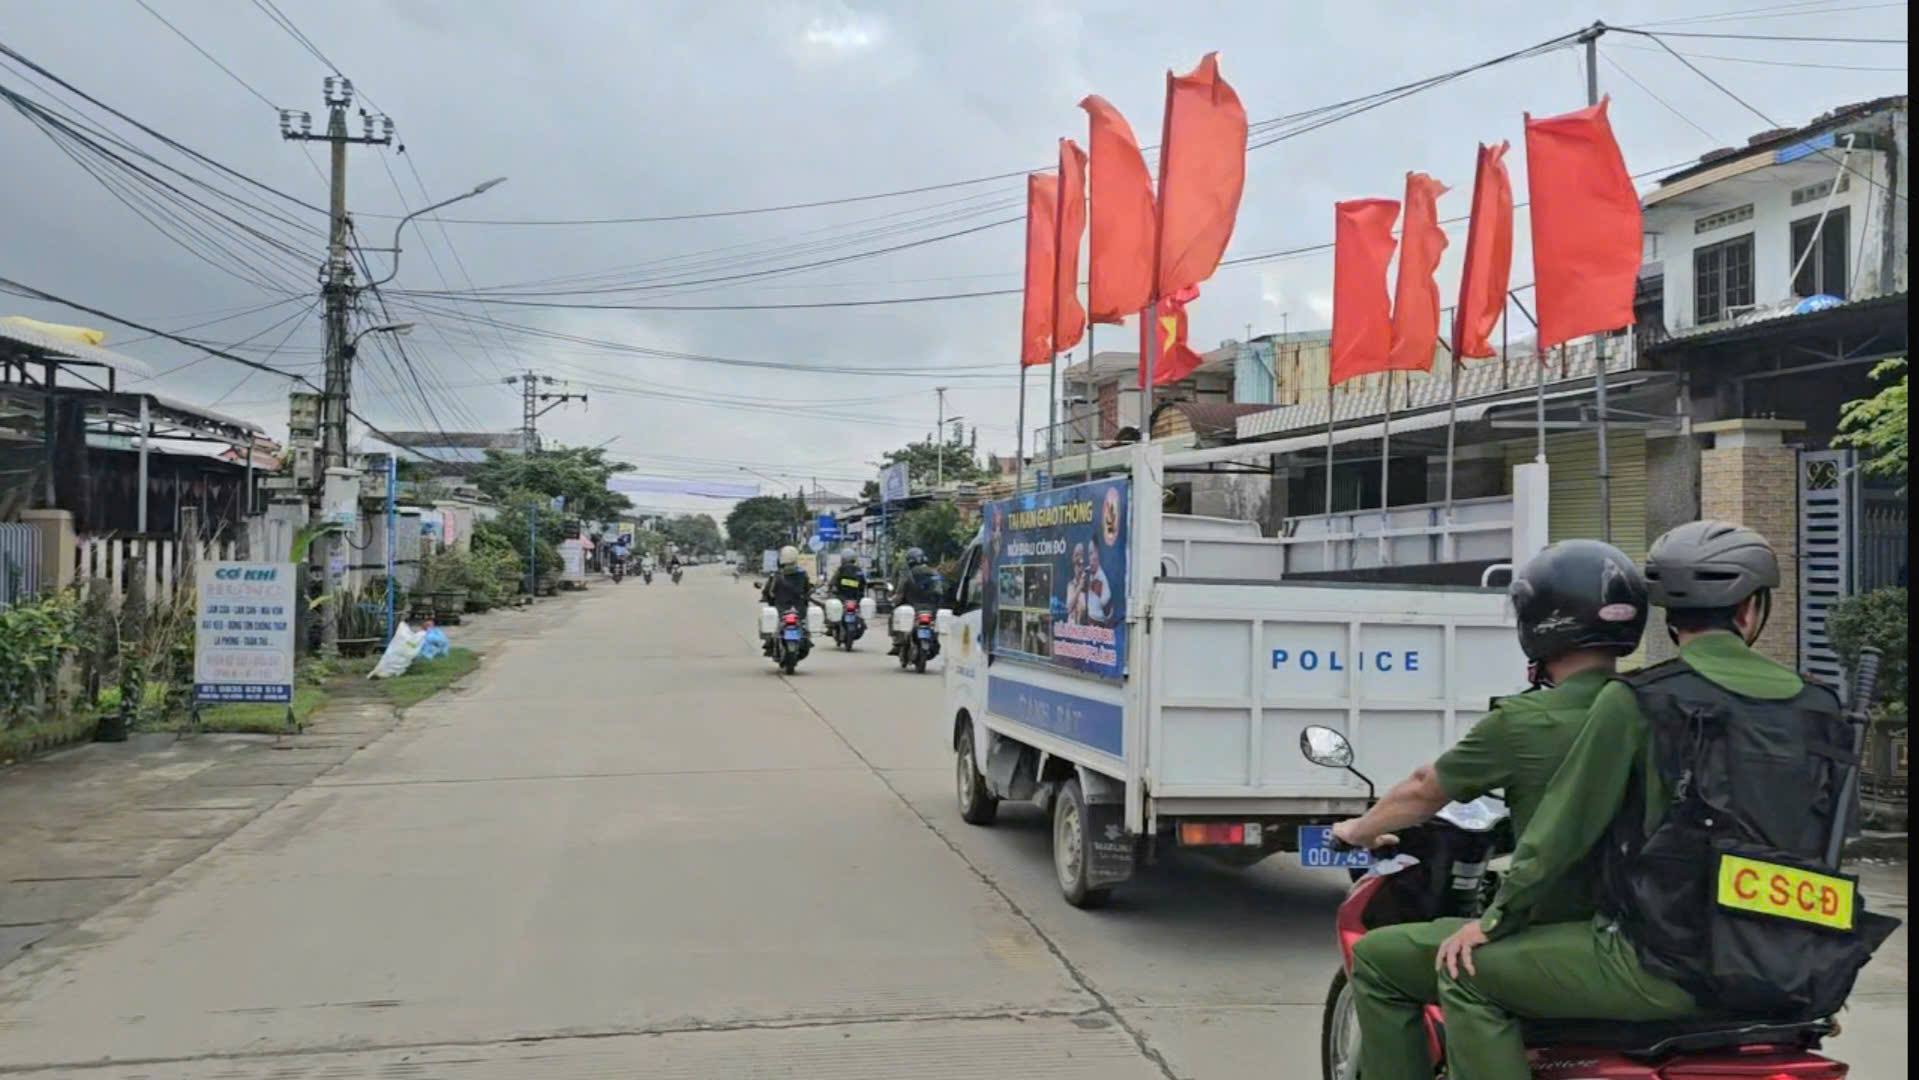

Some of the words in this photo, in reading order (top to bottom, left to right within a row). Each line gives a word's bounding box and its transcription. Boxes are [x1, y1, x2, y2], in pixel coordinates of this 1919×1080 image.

[1037, 507, 1058, 527] GIAO
[1060, 500, 1093, 524] THÔNG
[1271, 649, 1419, 671] POLICE
